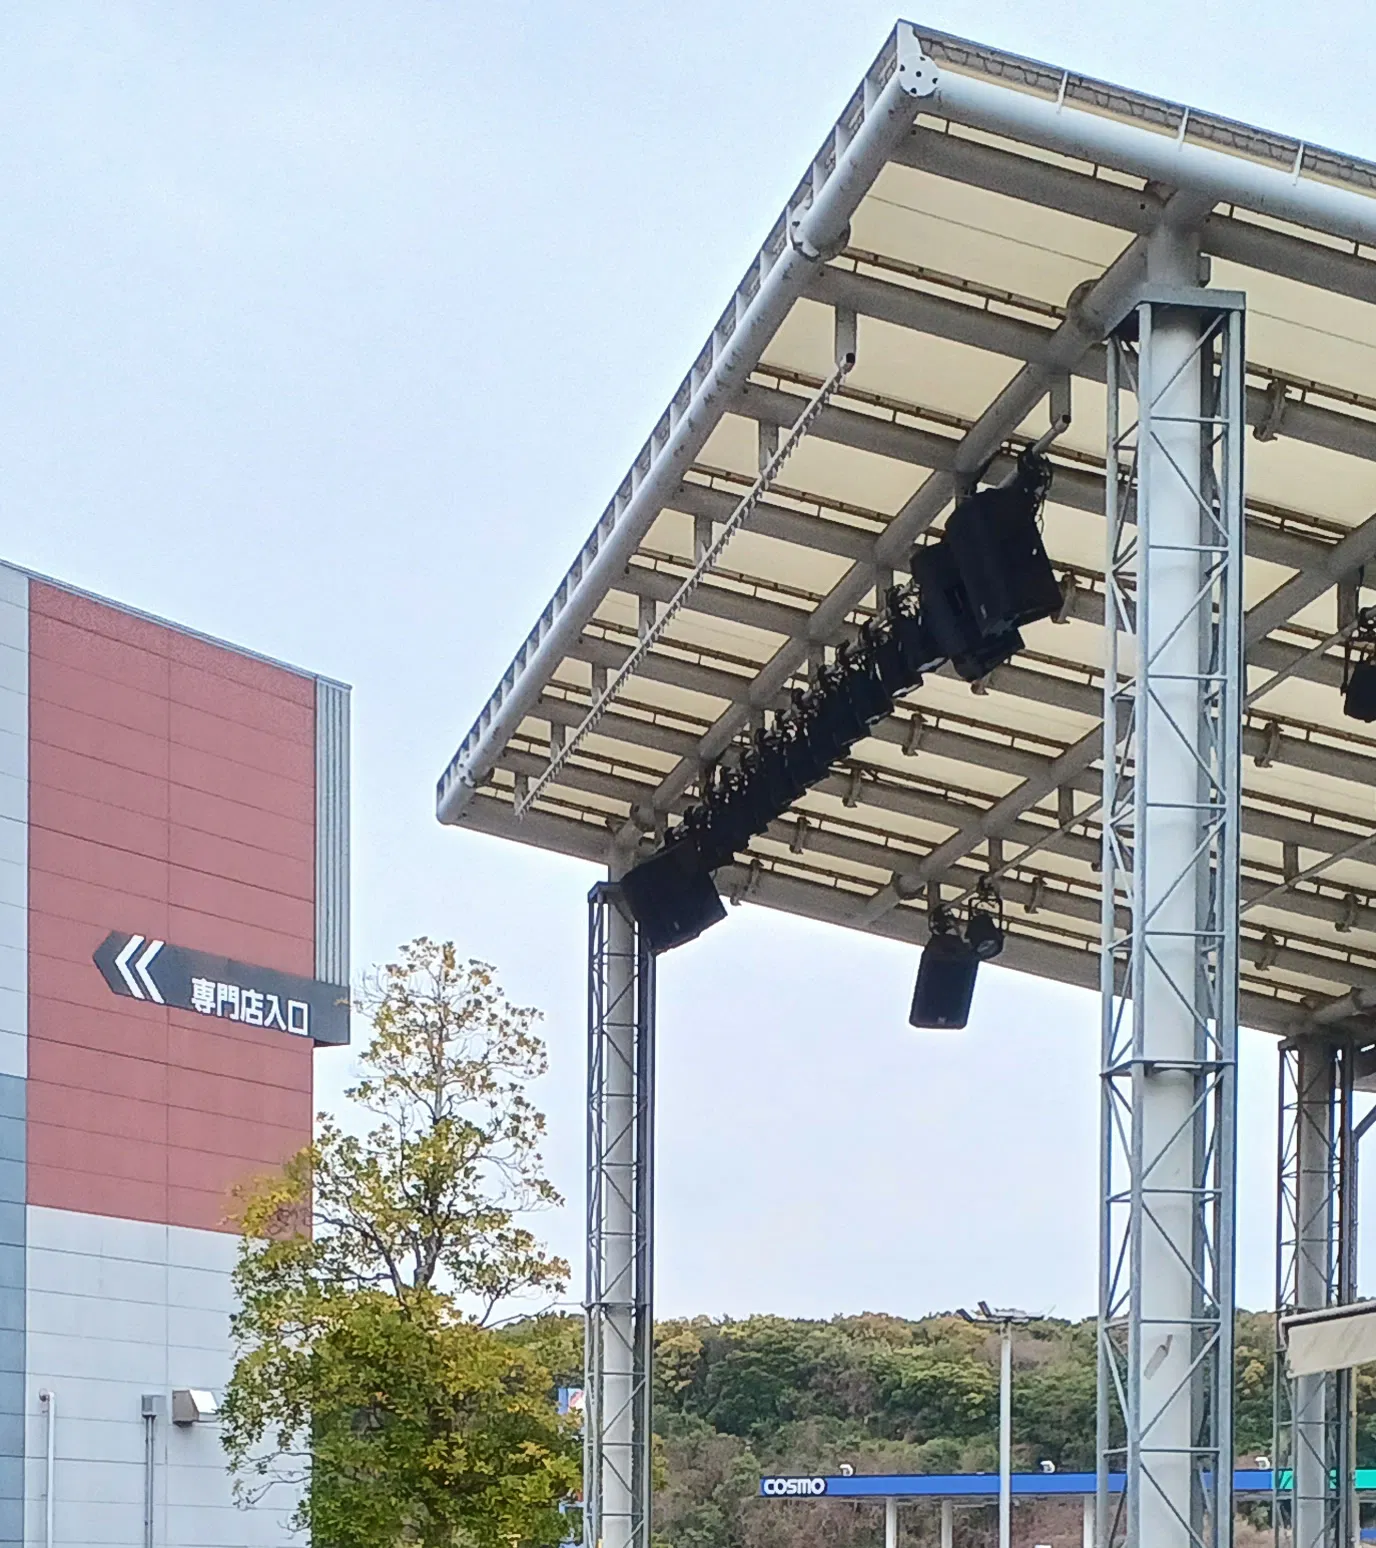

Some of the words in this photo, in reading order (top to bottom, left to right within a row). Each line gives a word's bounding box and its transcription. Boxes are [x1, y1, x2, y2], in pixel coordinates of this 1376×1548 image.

[191, 978, 309, 1036] 専門店入口
[764, 1478, 825, 1495] COSMO
